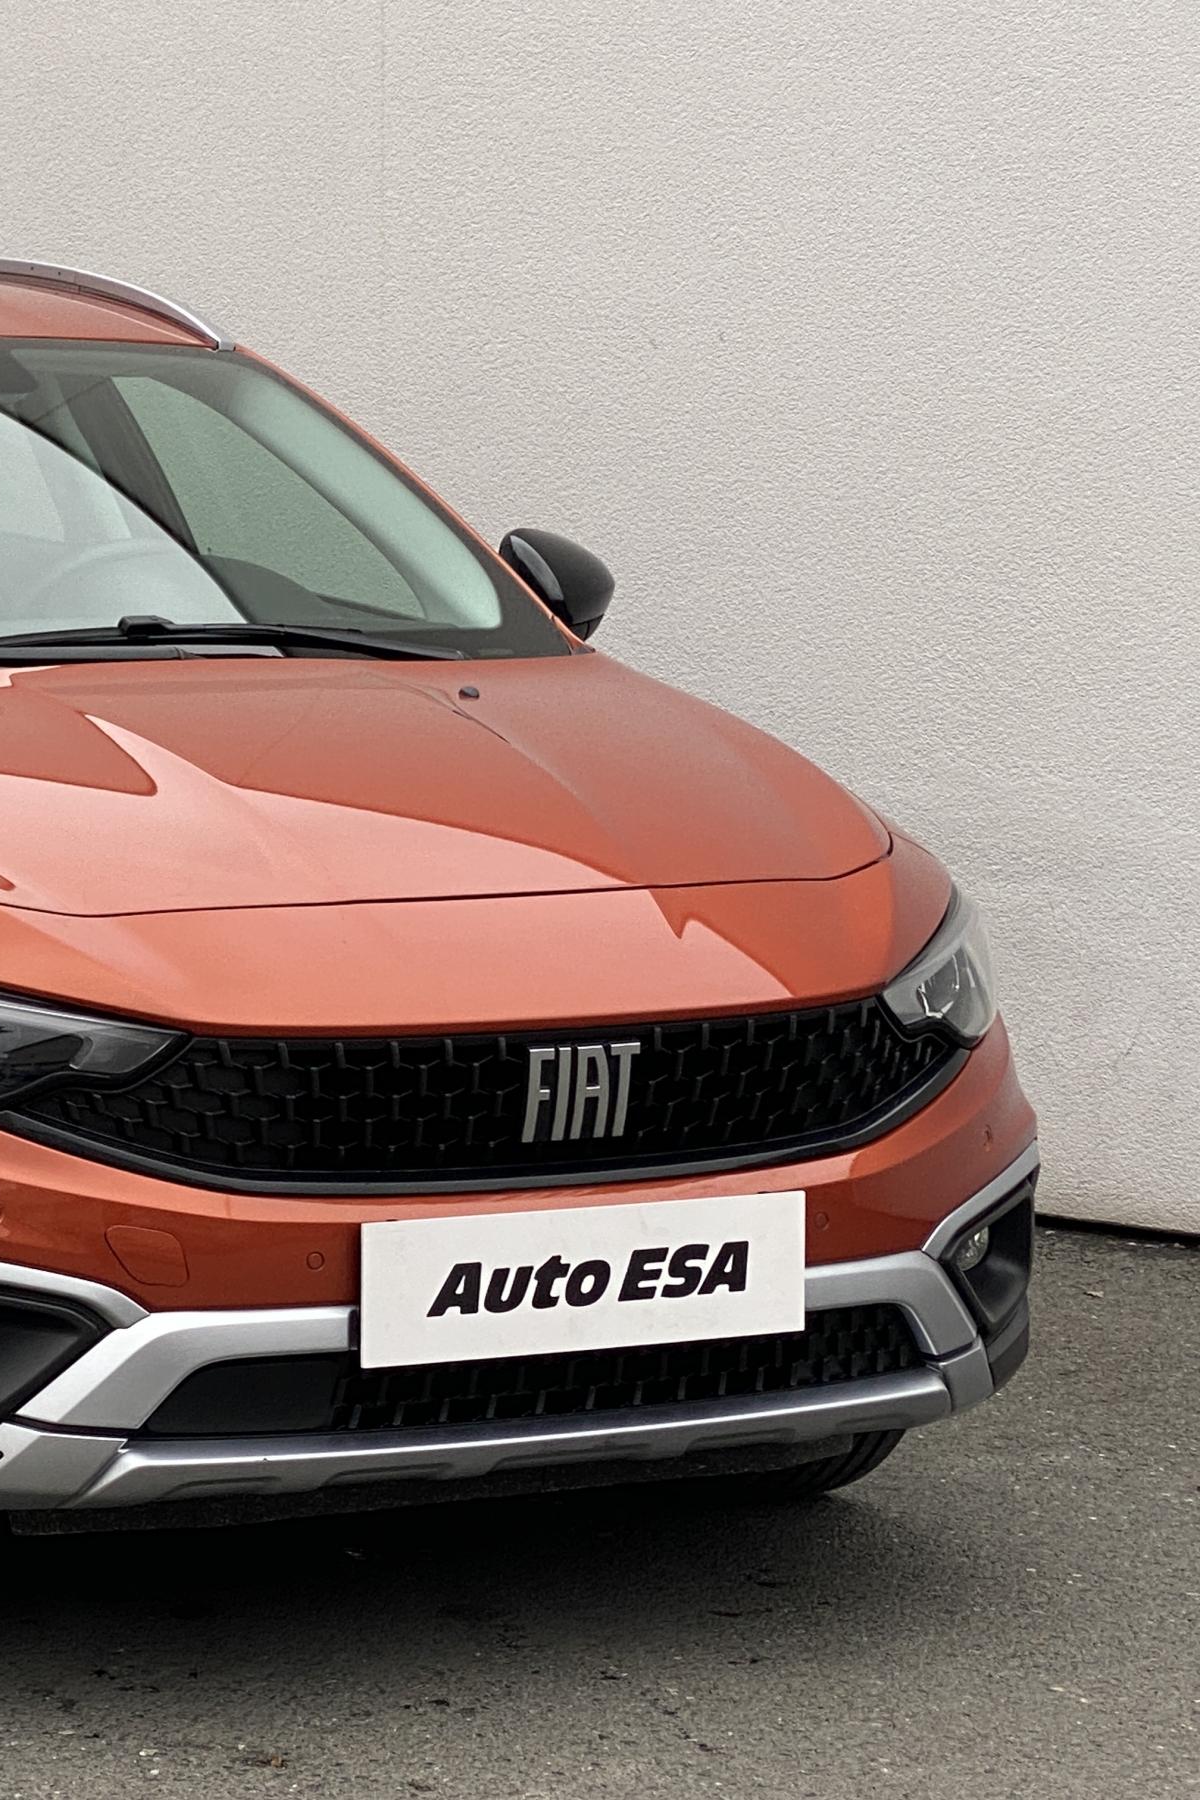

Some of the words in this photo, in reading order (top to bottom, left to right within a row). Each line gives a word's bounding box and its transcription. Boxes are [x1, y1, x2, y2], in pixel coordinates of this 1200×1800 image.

[521, 1042, 641, 1143] FIAT
[427, 1256, 611, 1317] Auto
[618, 1241, 749, 1303] ESA
